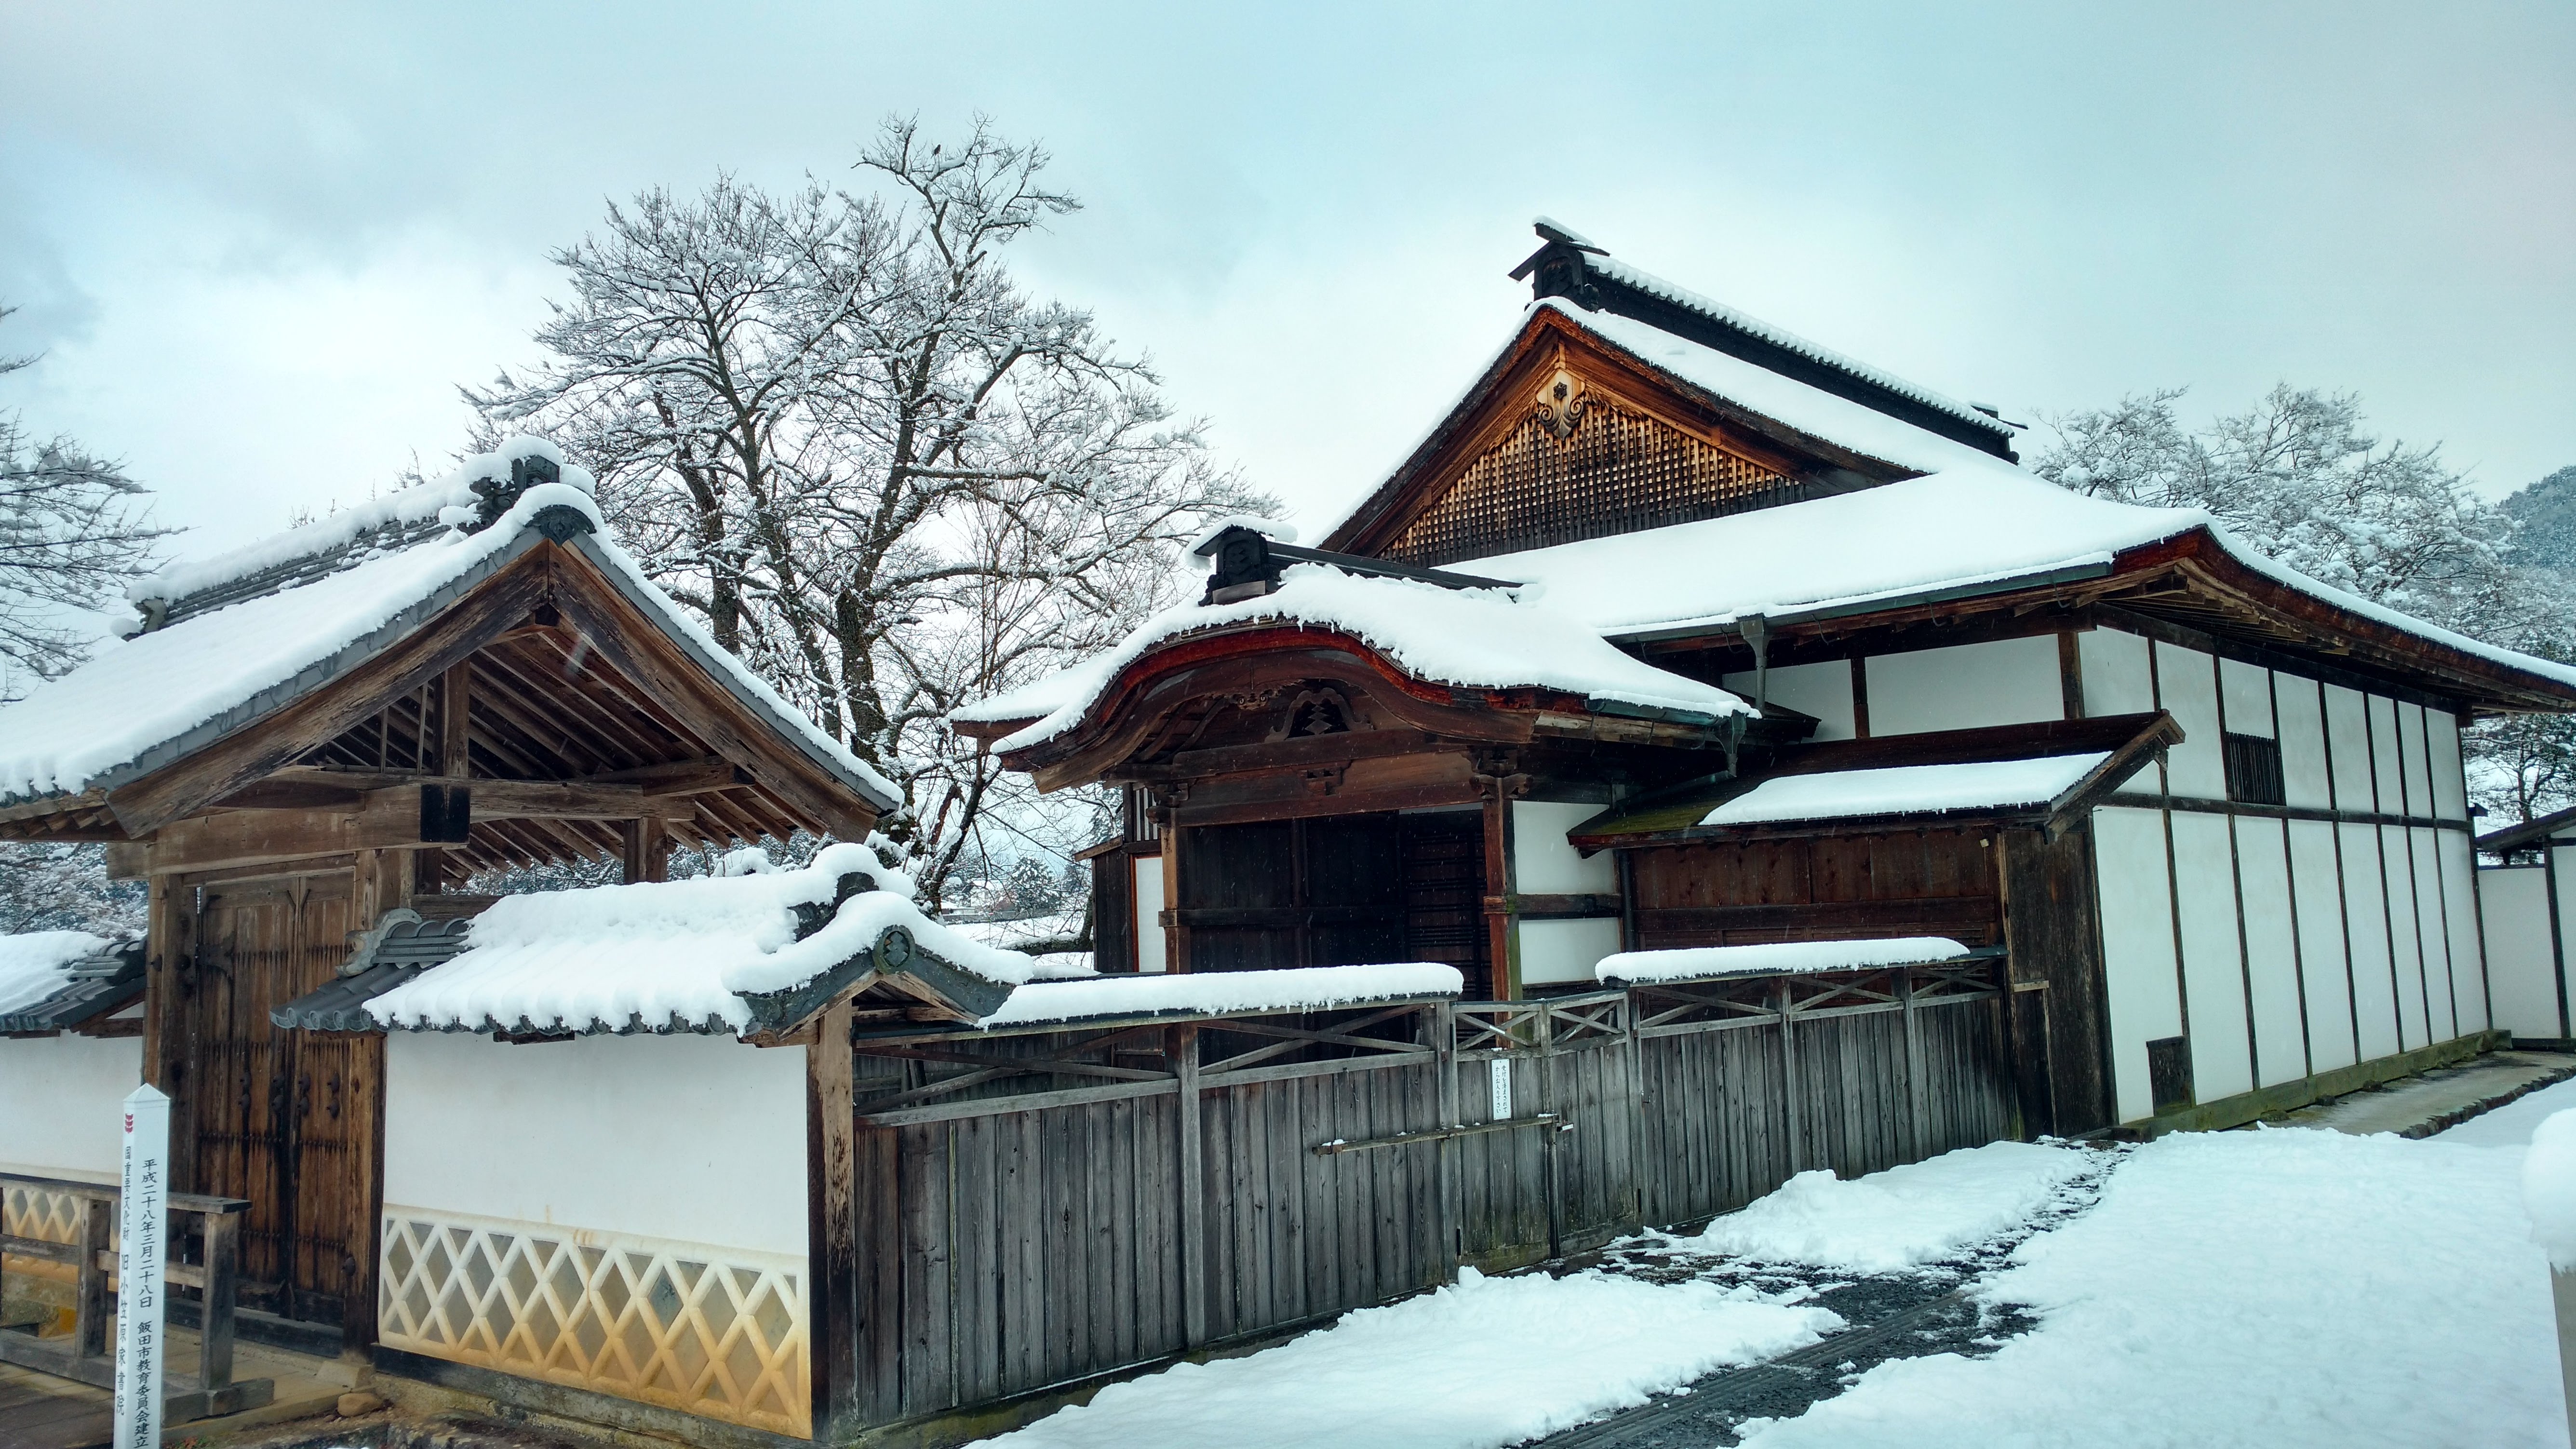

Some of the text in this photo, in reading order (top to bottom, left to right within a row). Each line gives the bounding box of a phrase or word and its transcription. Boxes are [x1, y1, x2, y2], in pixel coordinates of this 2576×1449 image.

[117, 1146, 131, 1415] 国重要文化財 旧小笠原家書院
[134, 1159, 157, 1449] 平成二十八年三月二十八日 飯田市教育委員会建立
